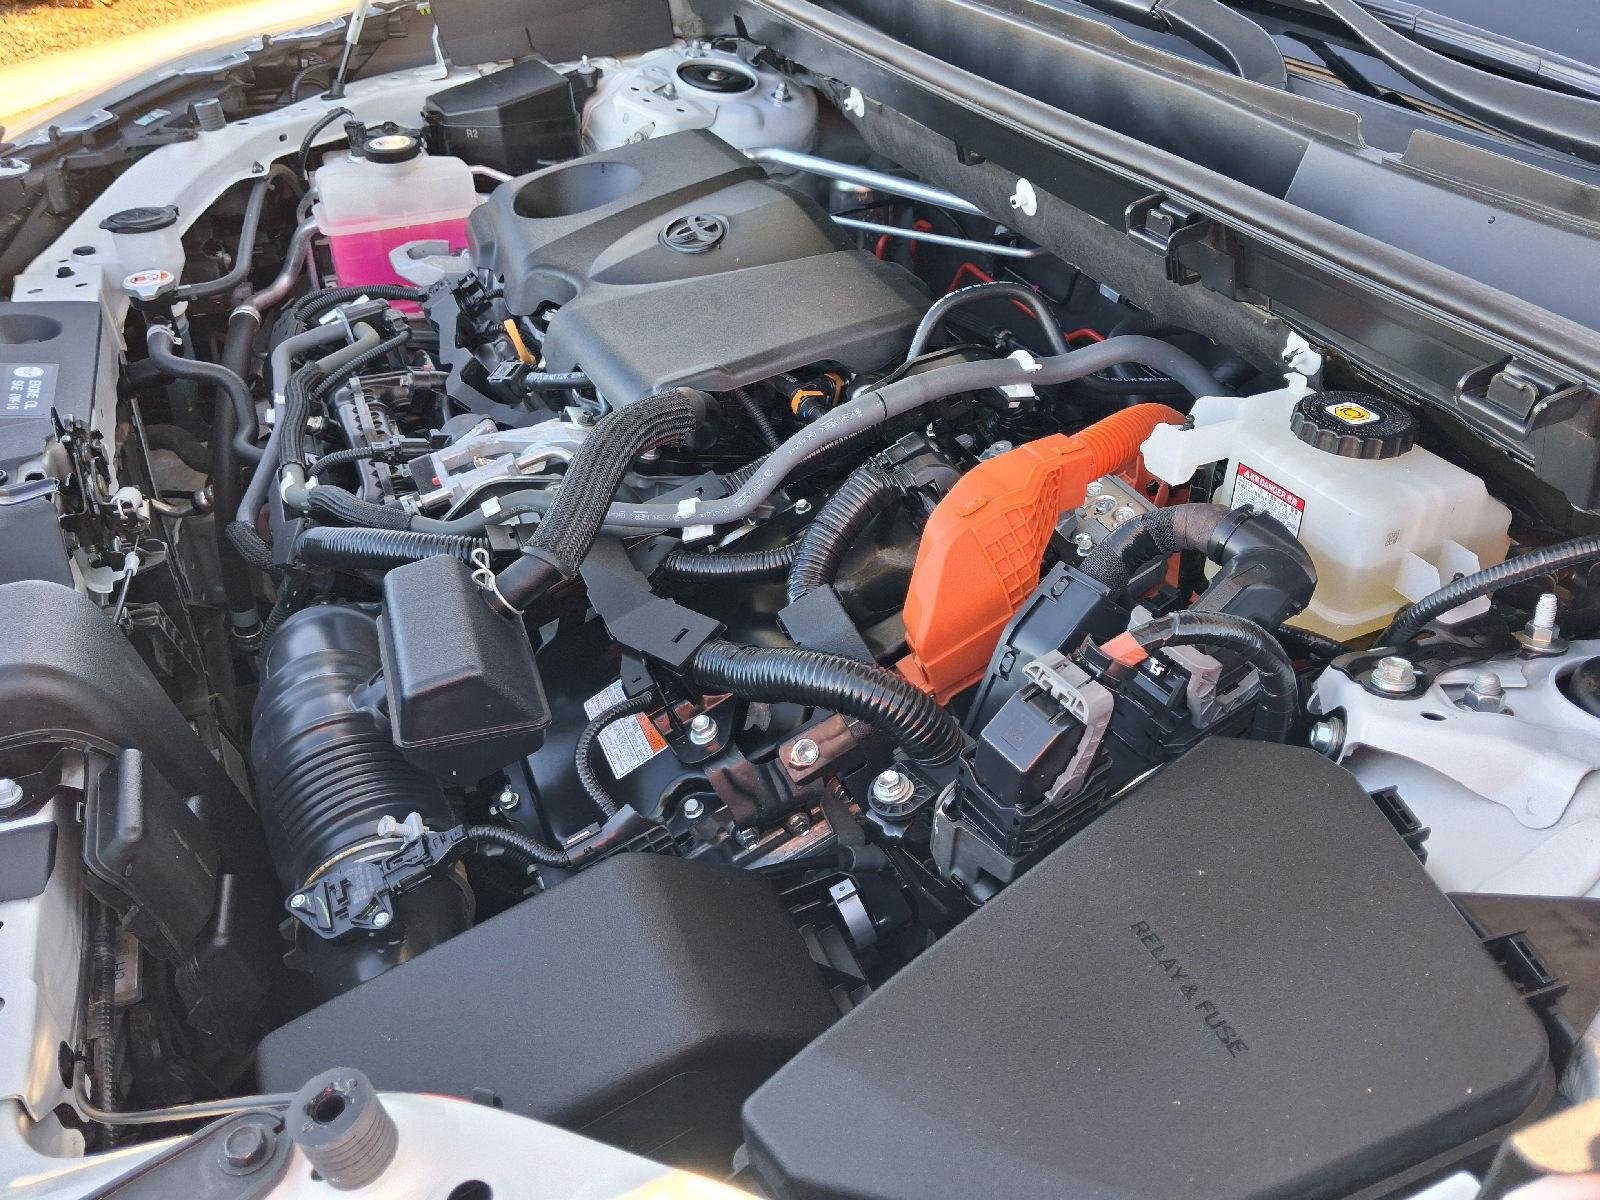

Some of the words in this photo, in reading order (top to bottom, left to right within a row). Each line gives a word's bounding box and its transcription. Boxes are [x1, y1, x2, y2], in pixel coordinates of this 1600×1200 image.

[465, 127, 479, 139] R2
[1259, 478, 1287, 499] DANGER
[1129, 920, 1189, 981] RELAY
[1179, 984, 1199, 1001] &
[1194, 1000, 1249, 1059] FUSE
